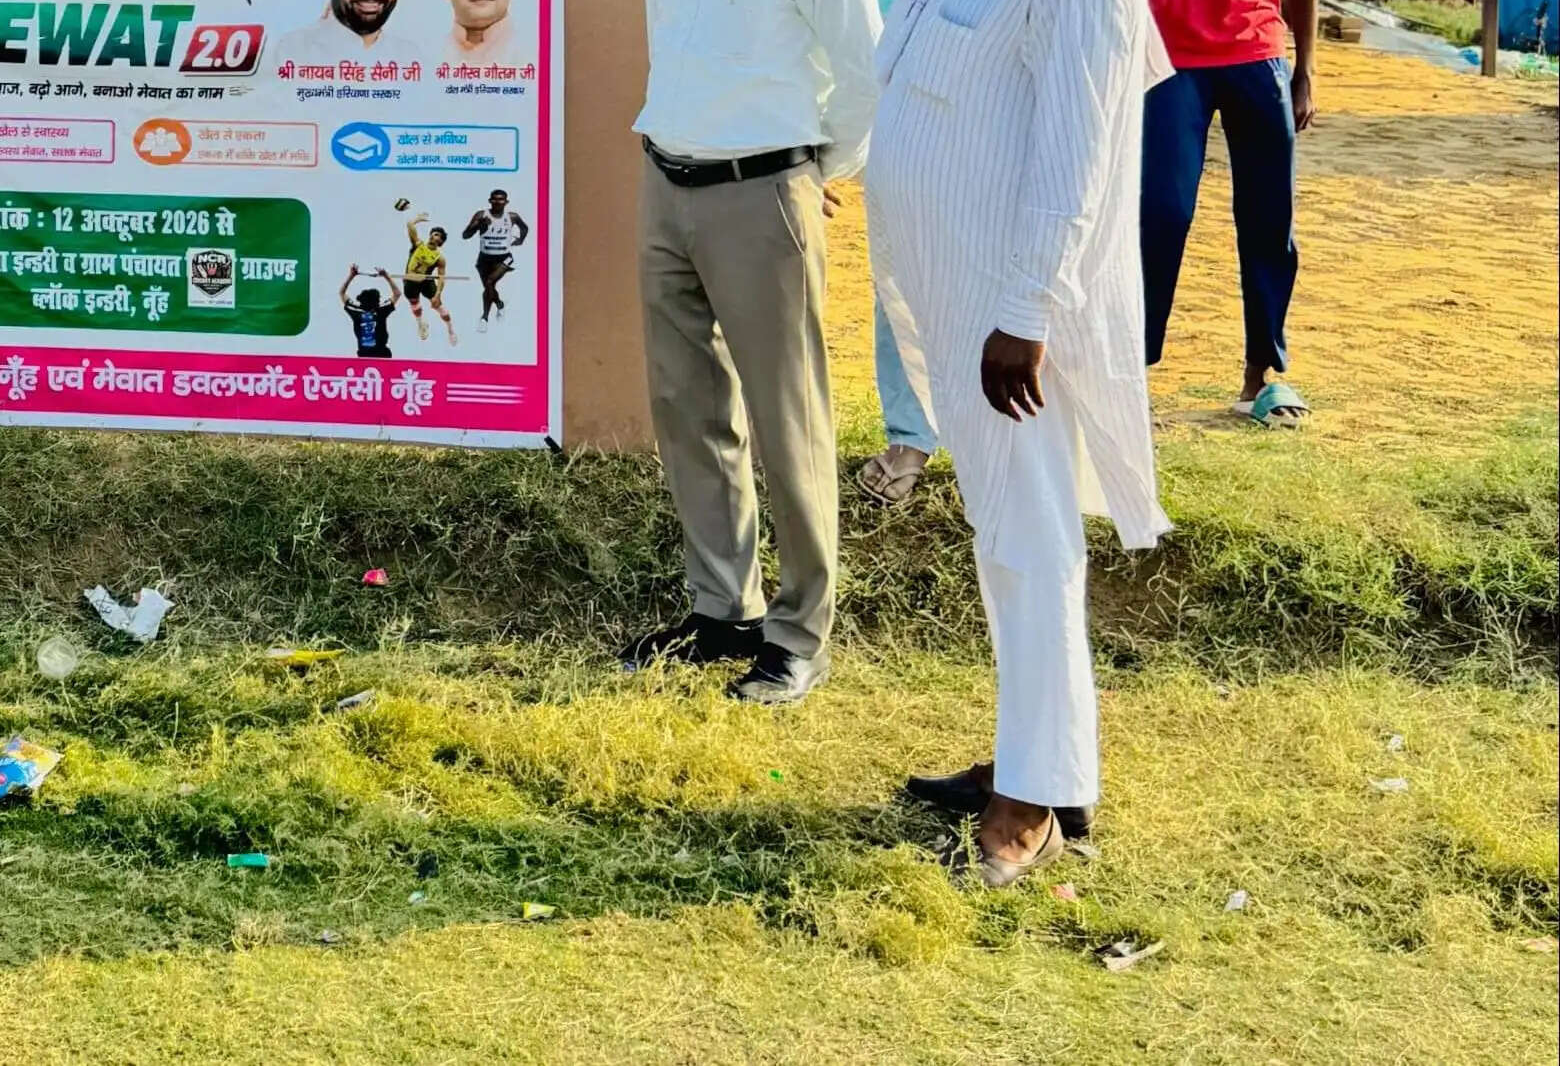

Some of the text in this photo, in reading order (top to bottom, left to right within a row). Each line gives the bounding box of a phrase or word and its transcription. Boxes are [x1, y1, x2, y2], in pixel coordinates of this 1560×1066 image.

[192, 30, 251, 68] 2.0
[278, 60, 295, 81] श्री
[339, 60, 367, 82] सिंह
[370, 61, 398, 81] सैनी
[402, 61, 421, 81] जी
[519, 62, 535, 80] जी
[55, 80, 87, 98] आगे,
[137, 83, 173, 99] मेवात
[175, 87, 195, 99] का
[198, 87, 225, 99] नाम
[52, 207, 73, 231] 12
[81, 209, 157, 242] अक्टूबर
[161, 209, 210, 234] 2026
[215, 206, 237, 236] से
[11, 246, 60, 276] इन्डरी
[62, 252, 77, 274] व
[81, 253, 118, 275] ग्राम
[120, 247, 182, 277] पंचायत
[240, 257, 298, 281] ग्राउण्ड
[198, 254, 227, 263] NCR
[30, 282, 81, 310] ब्लॉक
[47, 358, 90, 391] एवं
[93, 358, 165, 393] मेवात
[172, 365, 298, 399] डवलपमेंट
